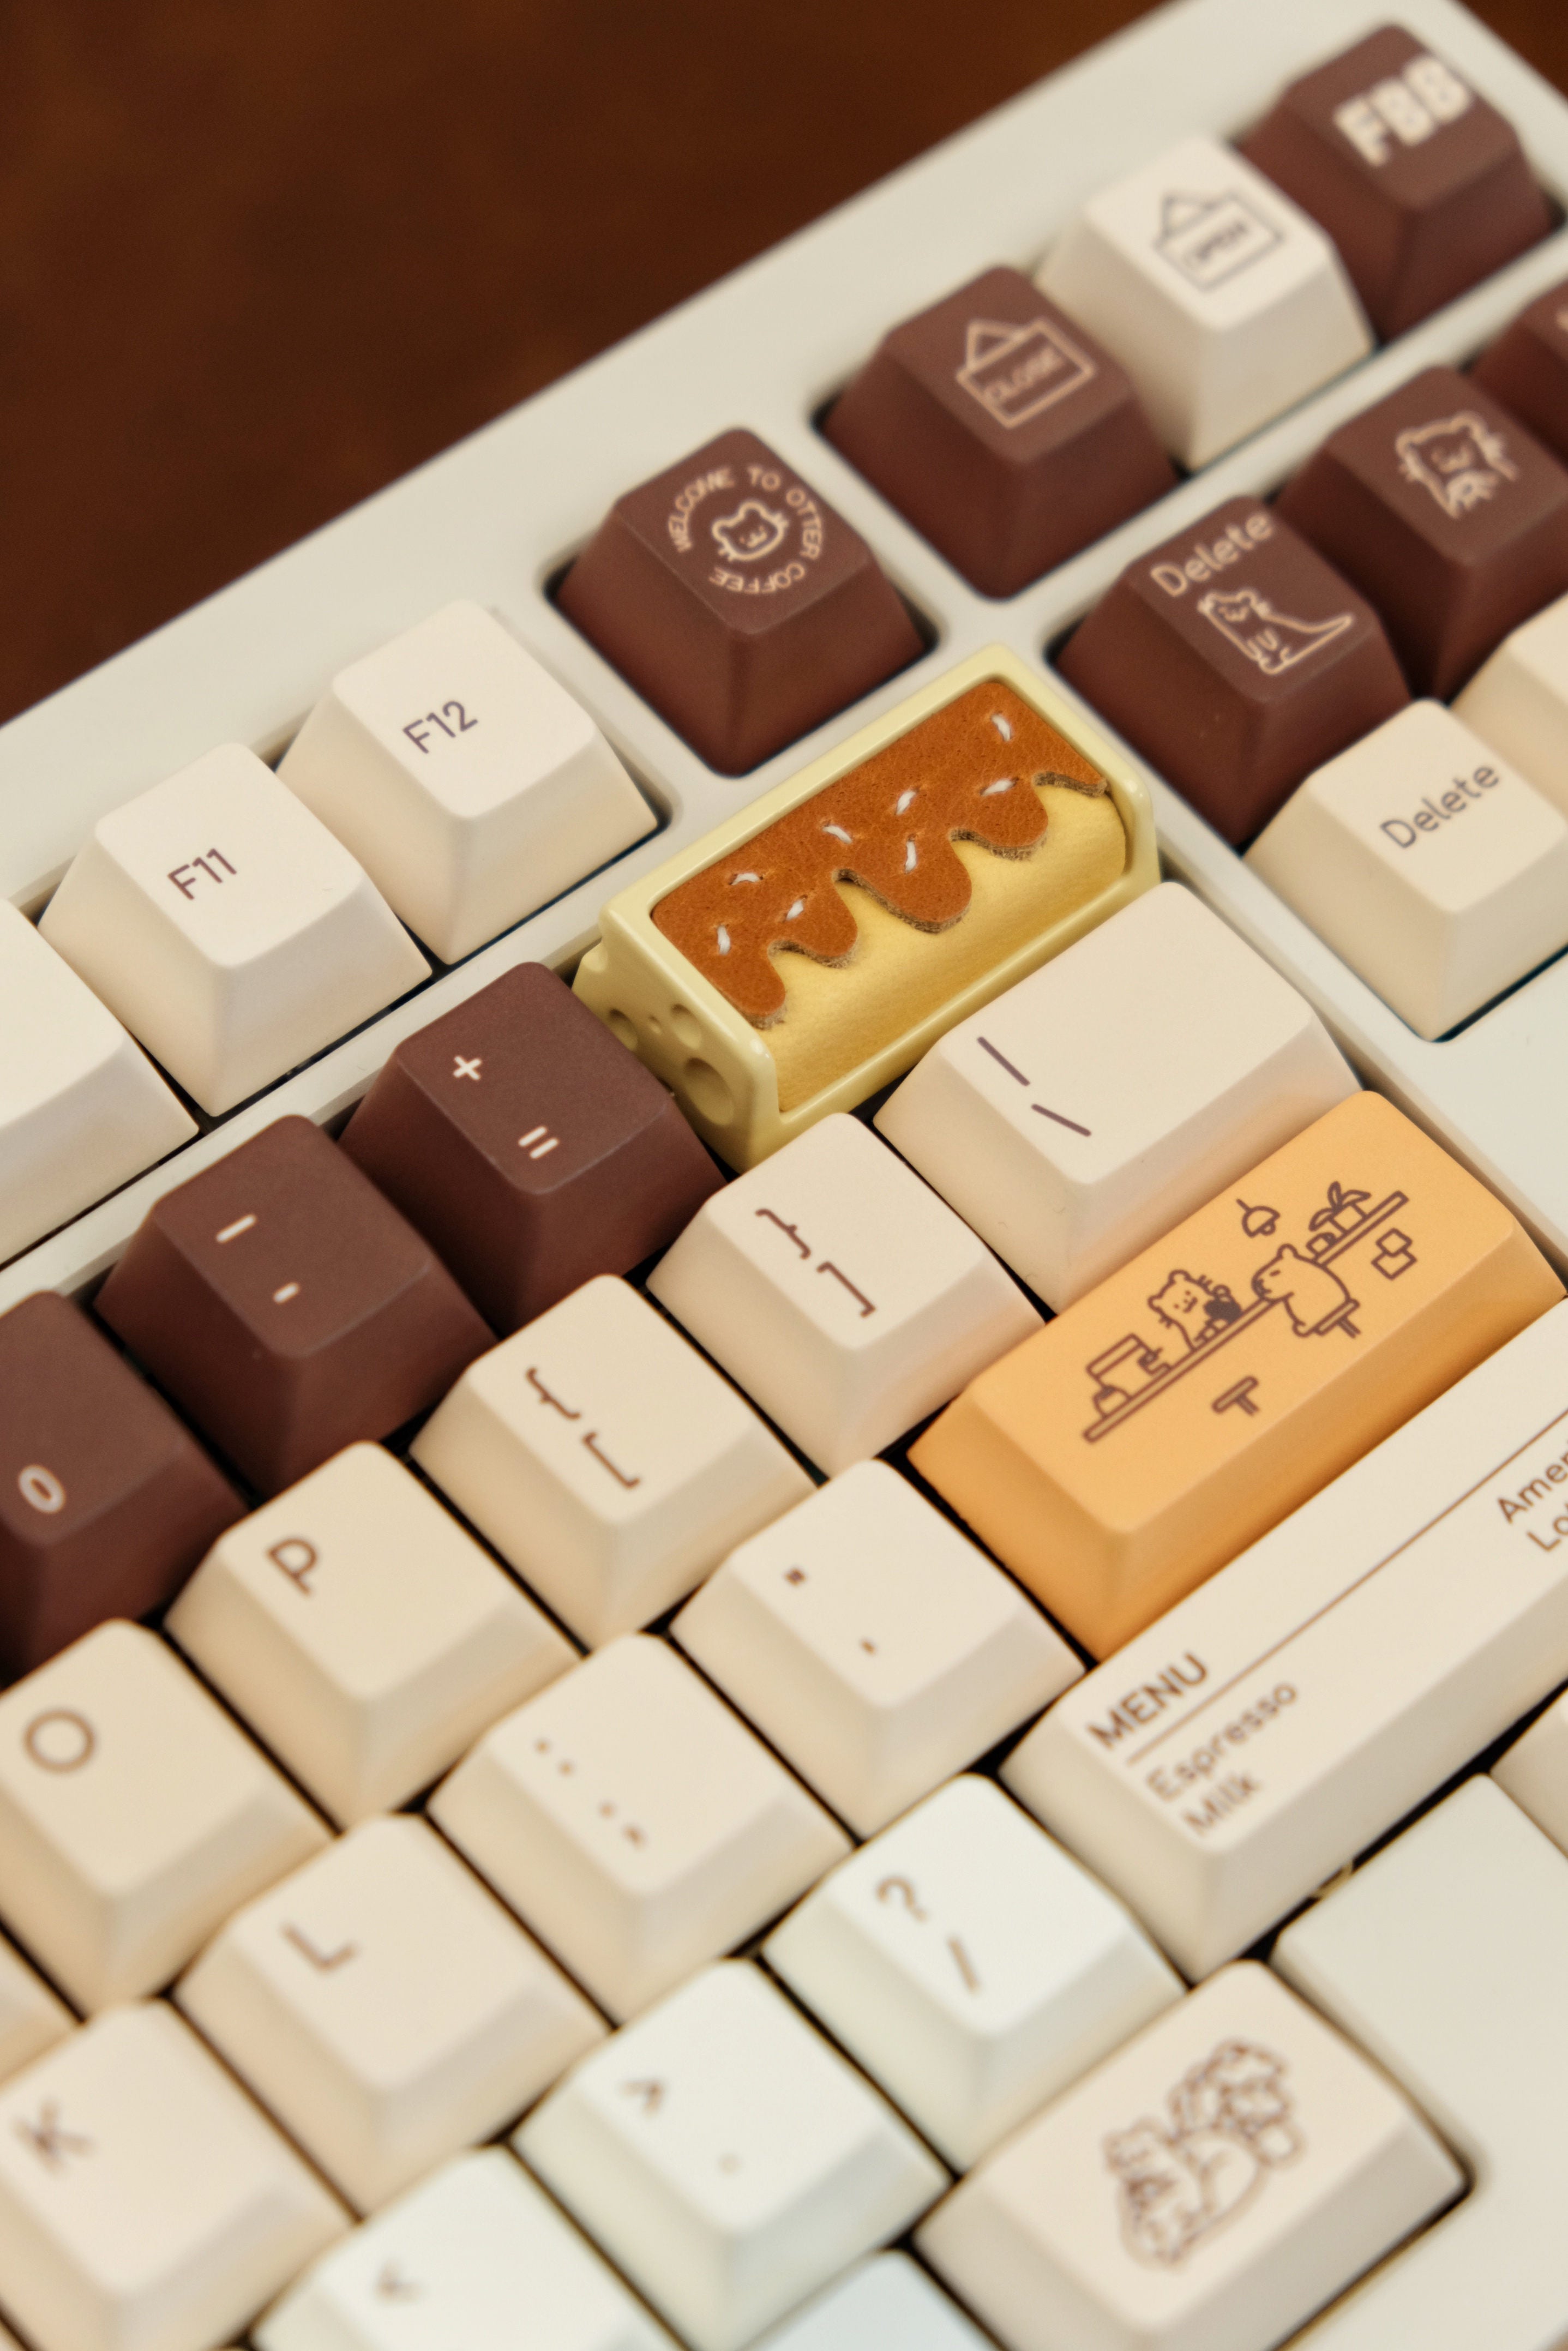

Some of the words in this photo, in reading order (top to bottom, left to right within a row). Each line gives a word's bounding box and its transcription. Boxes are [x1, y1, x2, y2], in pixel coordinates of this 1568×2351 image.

[748, 466, 781, 491] TO
[668, 467, 734, 552] WELCOME
[786, 489, 822, 560] OTTER
[709, 566, 805, 594] COFFEE
[1151, 512, 1272, 598] Delete
[402, 700, 478, 754] F12
[1379, 764, 1500, 849] Delete
[167, 847, 237, 900] F11
[453, 1055, 482, 1080] +
[518, 1126, 559, 1159] =
[1031, 1104, 1091, 1137] \
[755, 1208, 811, 1260] }
[818, 1261, 876, 1318] ]
[526, 1368, 581, 1420] {
[582, 1432, 640, 1490] [
[1526, 1502, 1568, 1552] Lo
[266, 1537, 318, 1597] P
[1087, 1652, 1209, 1749] MENU
[23, 1708, 96, 1774] O
[1146, 1682, 1298, 1802] Espresso
[1182, 1772, 1261, 1836] Milk
[875, 1875, 928, 1923] ?
[280, 1920, 360, 1975] L
[946, 1933, 981, 1994] /
[15, 2099, 96, 2174] K
